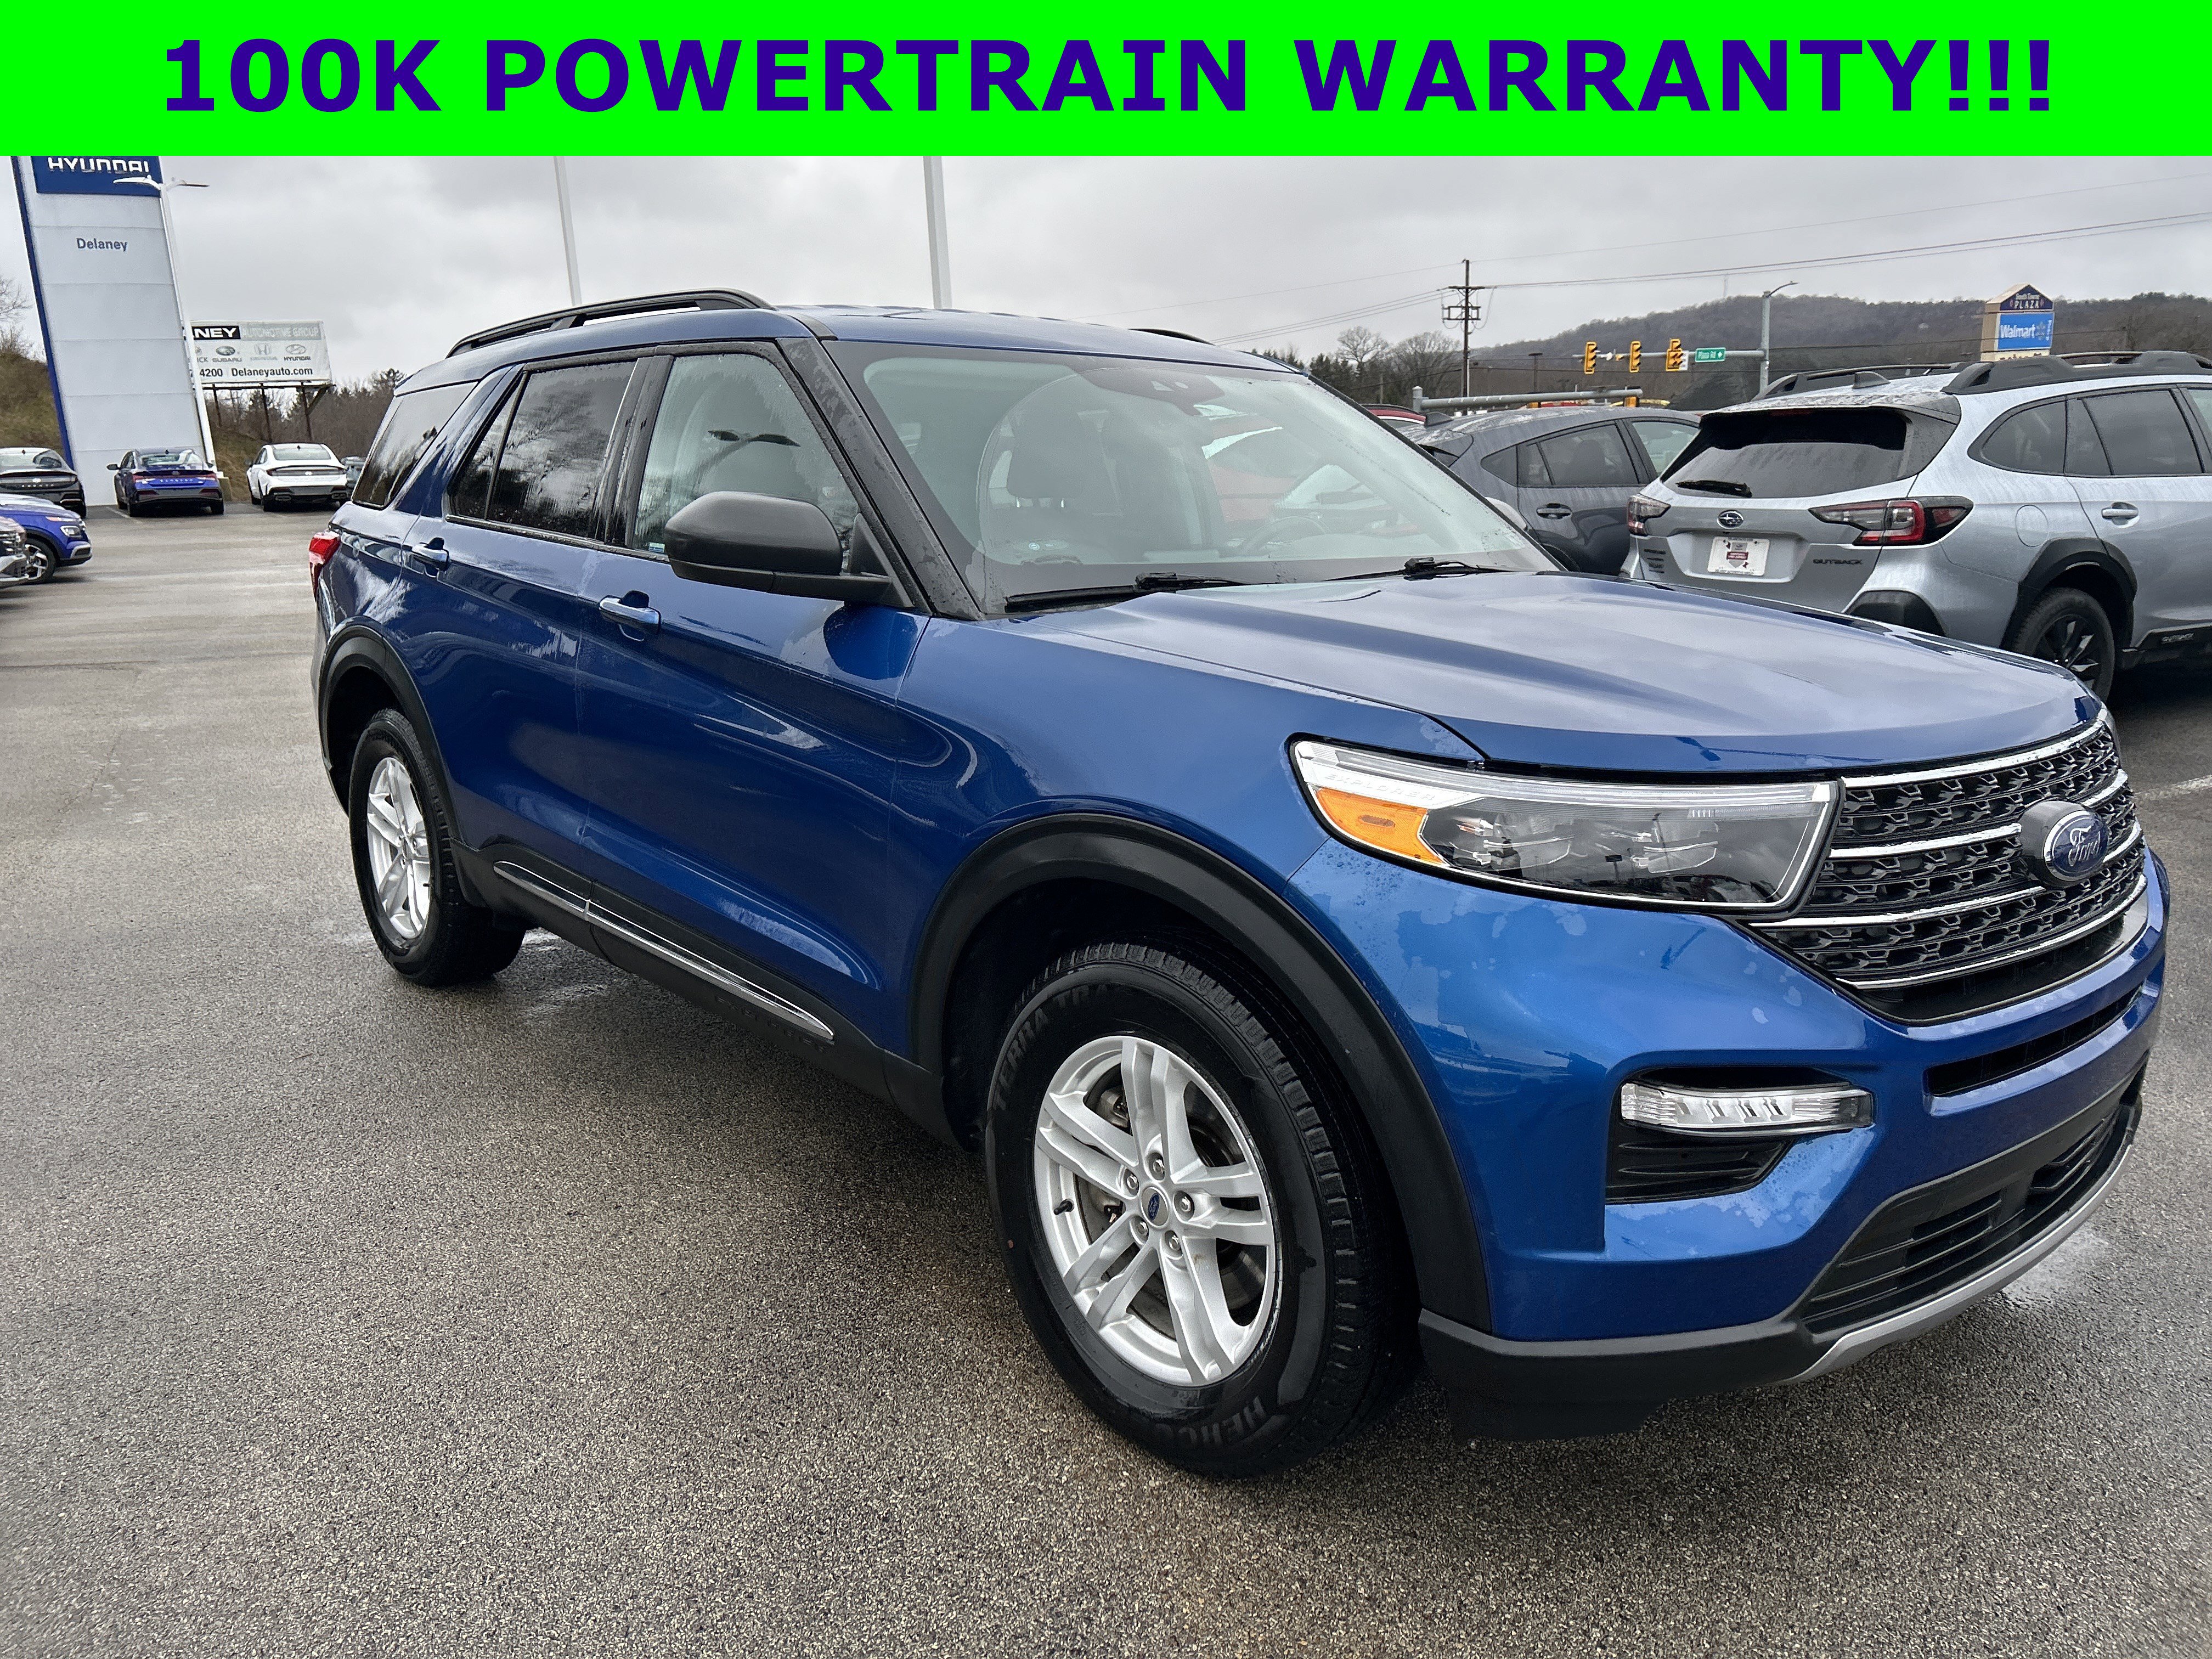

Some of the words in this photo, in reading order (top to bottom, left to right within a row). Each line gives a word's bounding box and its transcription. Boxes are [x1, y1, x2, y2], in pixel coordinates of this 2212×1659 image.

[48, 157, 149, 173] HYUNDAI
[76, 238, 128, 252] Delaney
[2014, 300, 2039, 309] PLAZA
[193, 328, 236, 338] NEY
[2000, 324, 2035, 338] Walmart
[199, 368, 223, 377] 4200
[231, 368, 313, 377] Delaneyauto.com
[1324, 774, 1436, 800] EXPLORER
[2068, 825, 2101, 867] Ford
